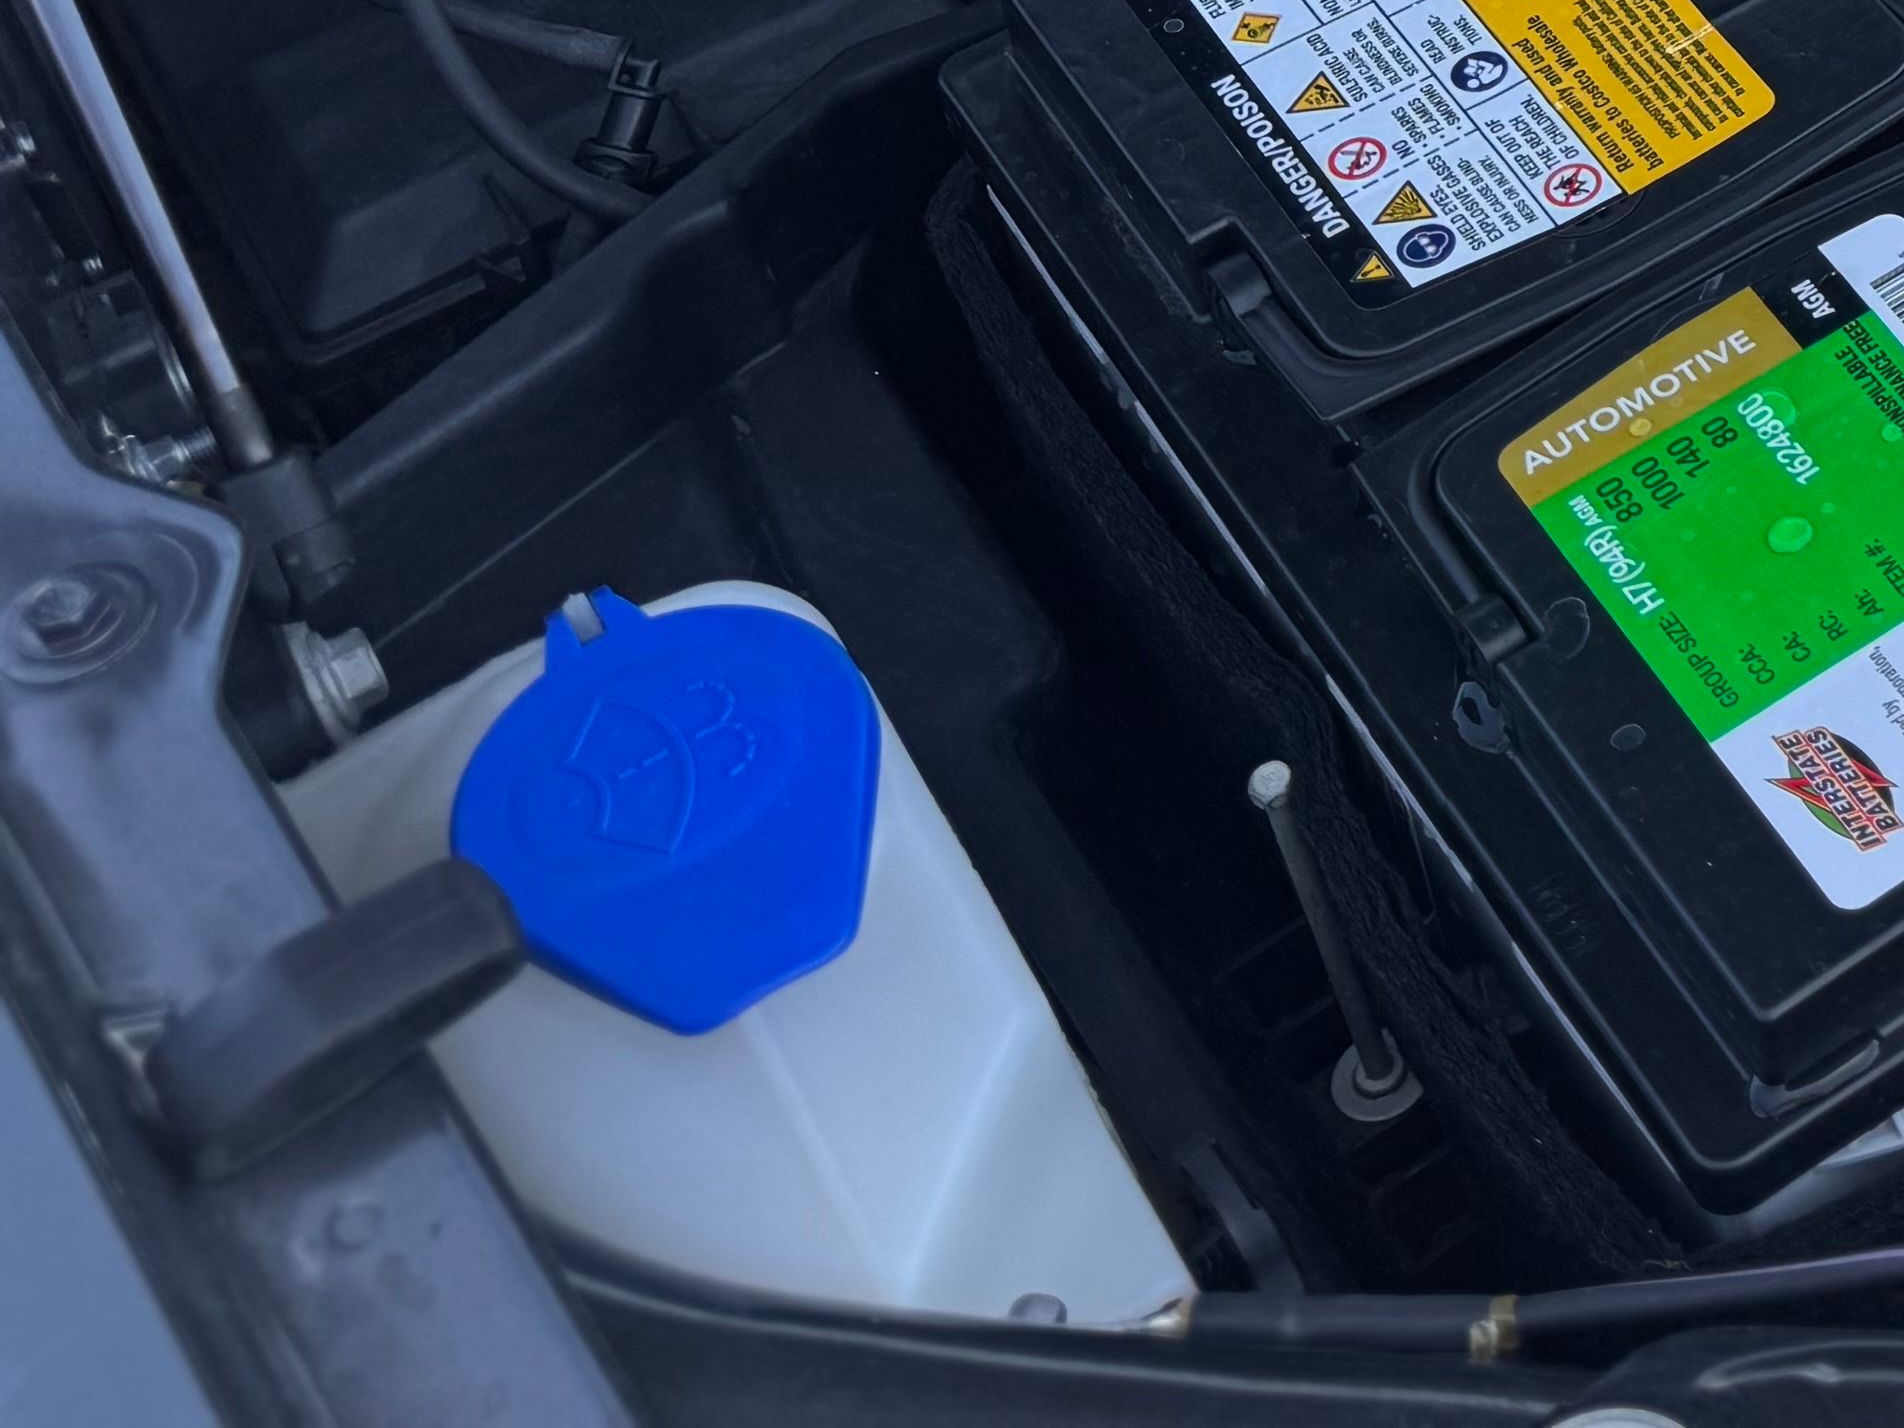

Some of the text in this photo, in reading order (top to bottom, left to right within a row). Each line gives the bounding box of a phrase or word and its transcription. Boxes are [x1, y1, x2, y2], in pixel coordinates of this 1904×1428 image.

[1350, 28, 1403, 85] BLINDNESS OR
[1418, 38, 1447, 63] READ
[1423, 12, 1466, 54] INSTRUC-
[1520, 14, 1580, 71] Wholesale
[1304, 32, 1370, 103] SULFURIC ACID
[1342, 47, 1386, 93] CAN CAUSE
[1388, 45, 1420, 77] SEVERE
[1419, 83, 1461, 126] SMOKING
[1510, 38, 1635, 172] Return warranty and used
[1568, 68, 1612, 108] Costco
[1600, 105, 1623, 121] to
[1389, 105, 1427, 143] SPARKS
[1406, 96, 1444, 134] FLAMES
[1508, 114, 1562, 169] THE REACH
[1517, 93, 1580, 159] OF CHILDREN.
[1209, 73, 1353, 238] DANGER/POISON
[1390, 138, 1415, 159] NO
[1483, 116, 1544, 179] KEEP OUT OF
[1609, 118, 1666, 170] batteries
[1425, 153, 1505, 242] EXPLOSIVE GASES
[1453, 155, 1522, 231] CAN CAUSE BLIND-
[1501, 185, 1521, 200] OR
[1511, 198, 1539, 223] NESS
[1449, 213, 1488, 251] SHIELD
[1789, 277, 1835, 321] AGM
[1841, 318, 1879, 355] FREE
[1515, 327, 1757, 476] AUTOMOTIVE
[1733, 390, 1824, 487] 1624800
[1567, 493, 1603, 529] AGM
[1663, 432, 1849, 642] RC: 140
[1698, 412, 1884, 620] Ah: 80
[1593, 474, 1778, 687] CCA: 850
[1628, 453, 1813, 664] CA: 1000
[1655, 609, 1698, 654] SIZE:
[1685, 647, 1741, 709] GROUP
[1878, 696, 1904, 718] by
[1777, 728, 1882, 853] INTERSTATE
[1804, 724, 1899, 835] BATTERIES
